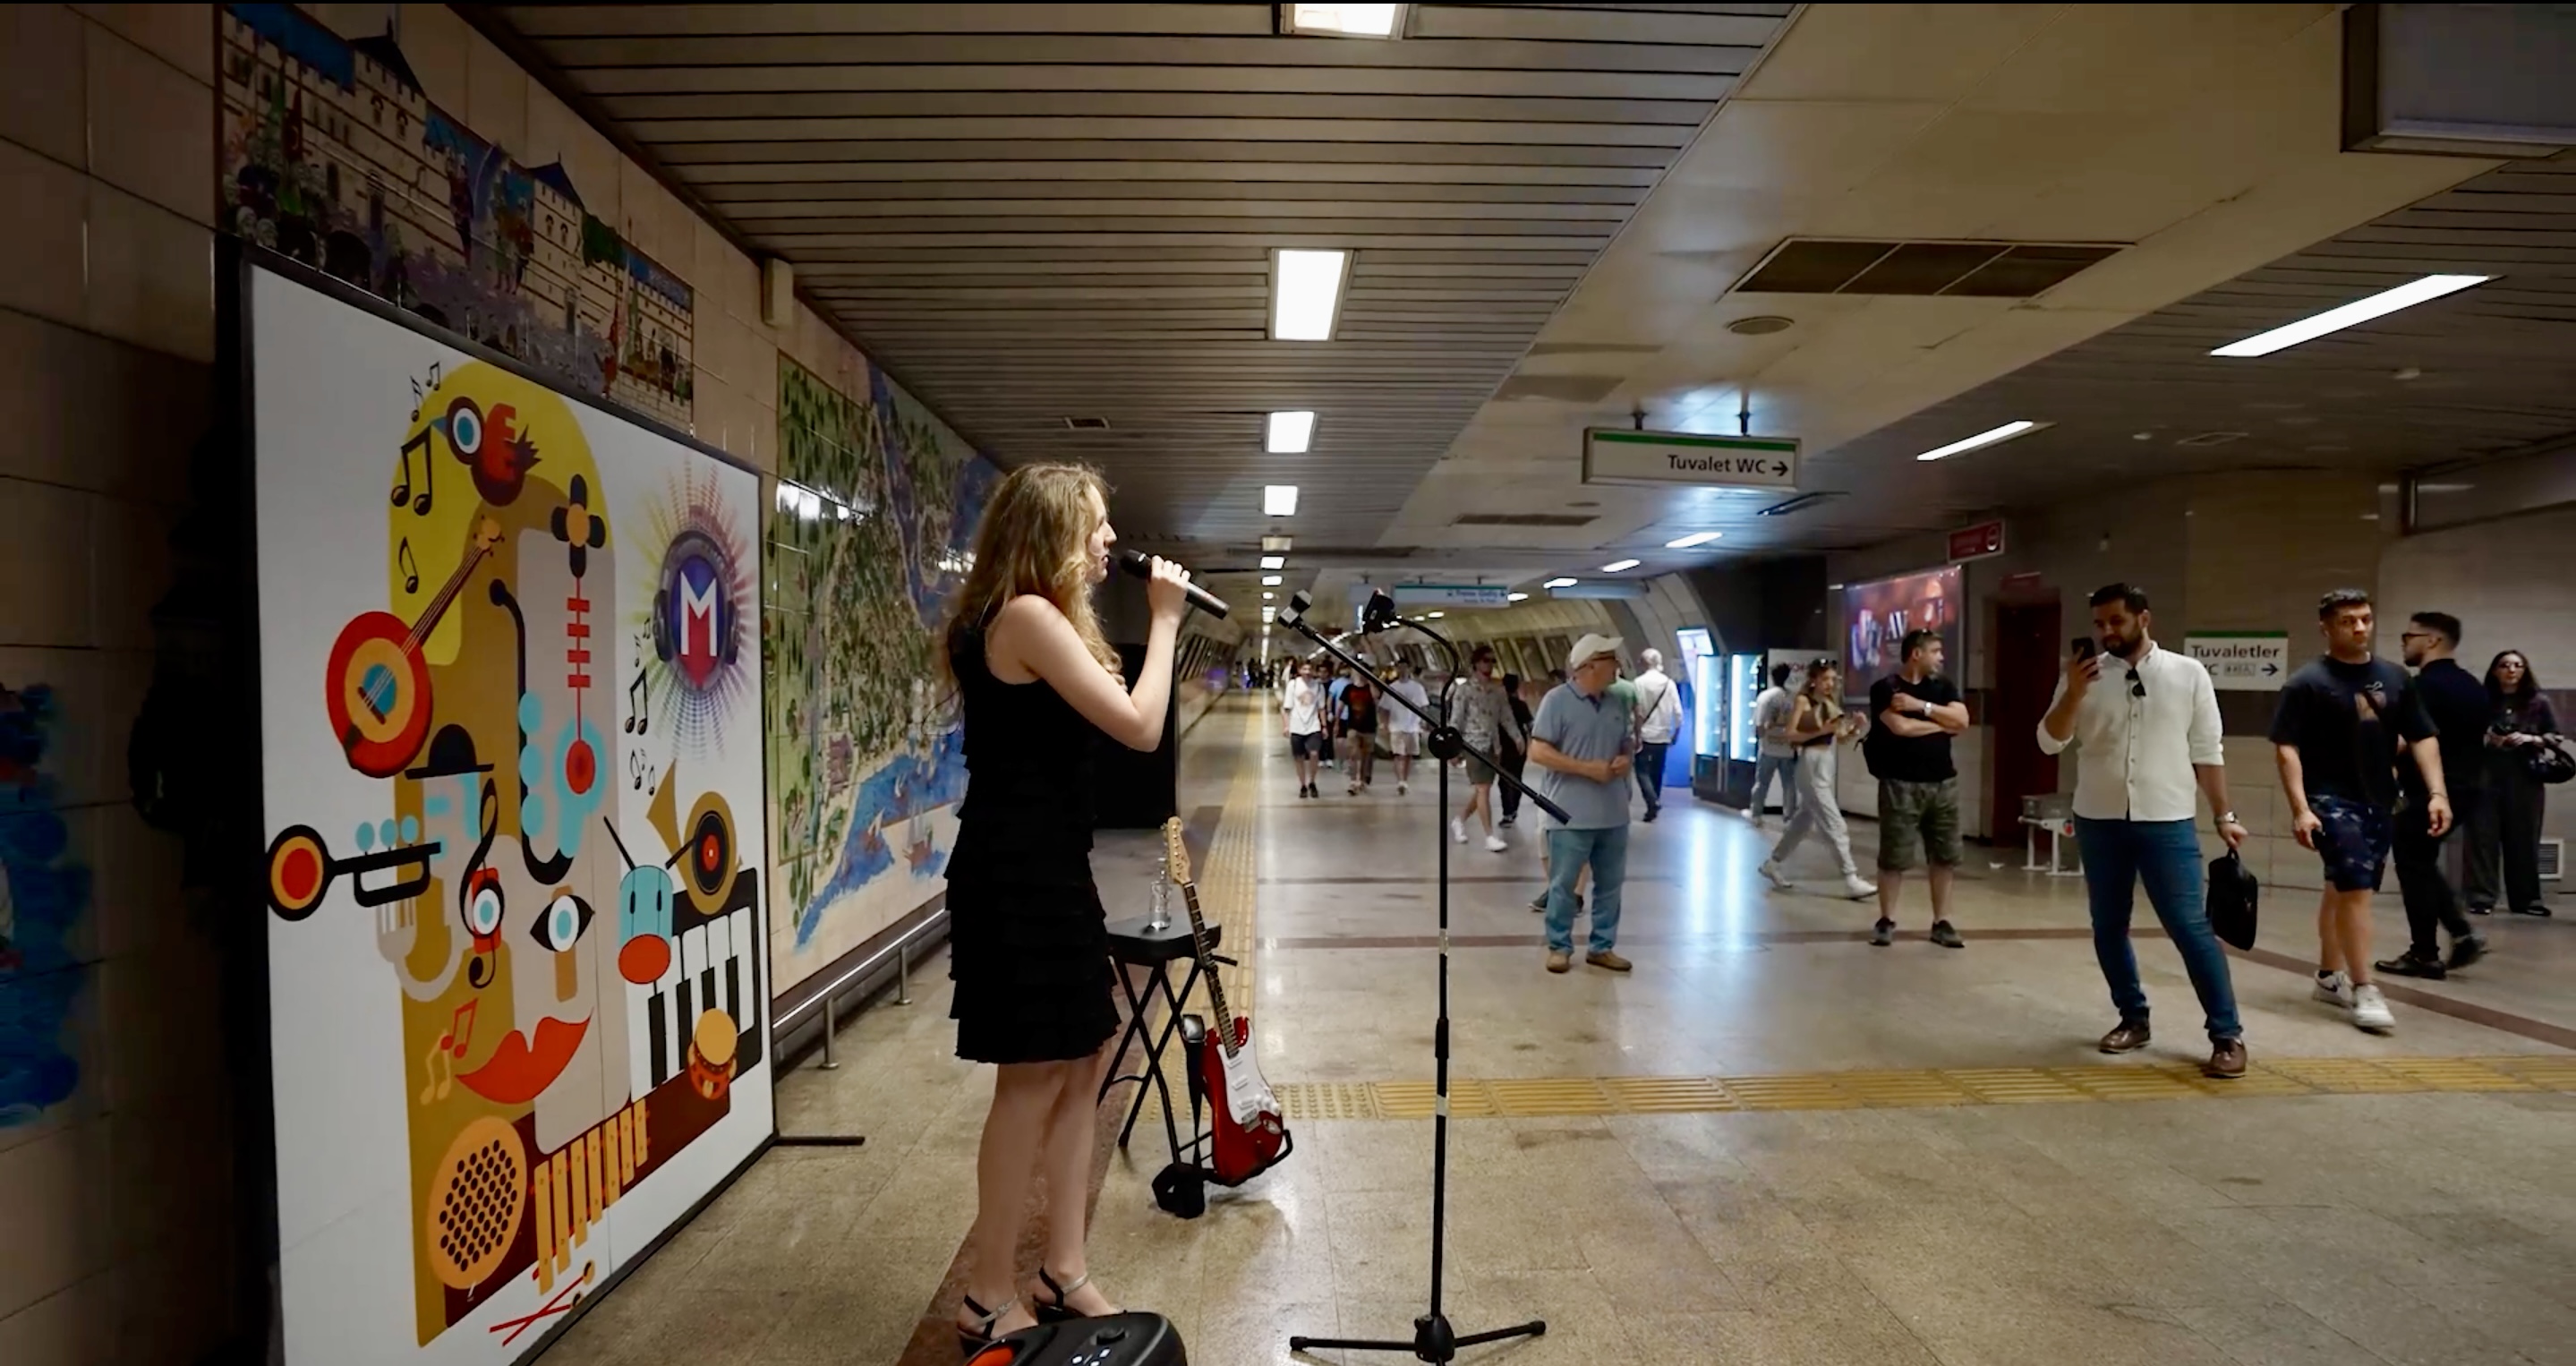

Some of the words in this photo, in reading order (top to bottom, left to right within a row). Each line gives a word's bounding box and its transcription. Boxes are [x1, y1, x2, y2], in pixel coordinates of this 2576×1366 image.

[1668, 454, 1731, 473] Tuvalet
[1736, 457, 1767, 474] WC
[679, 571, 718, 657] M
[2191, 644, 2281, 659] Tuvaletler
[2205, 663, 2219, 676] C
